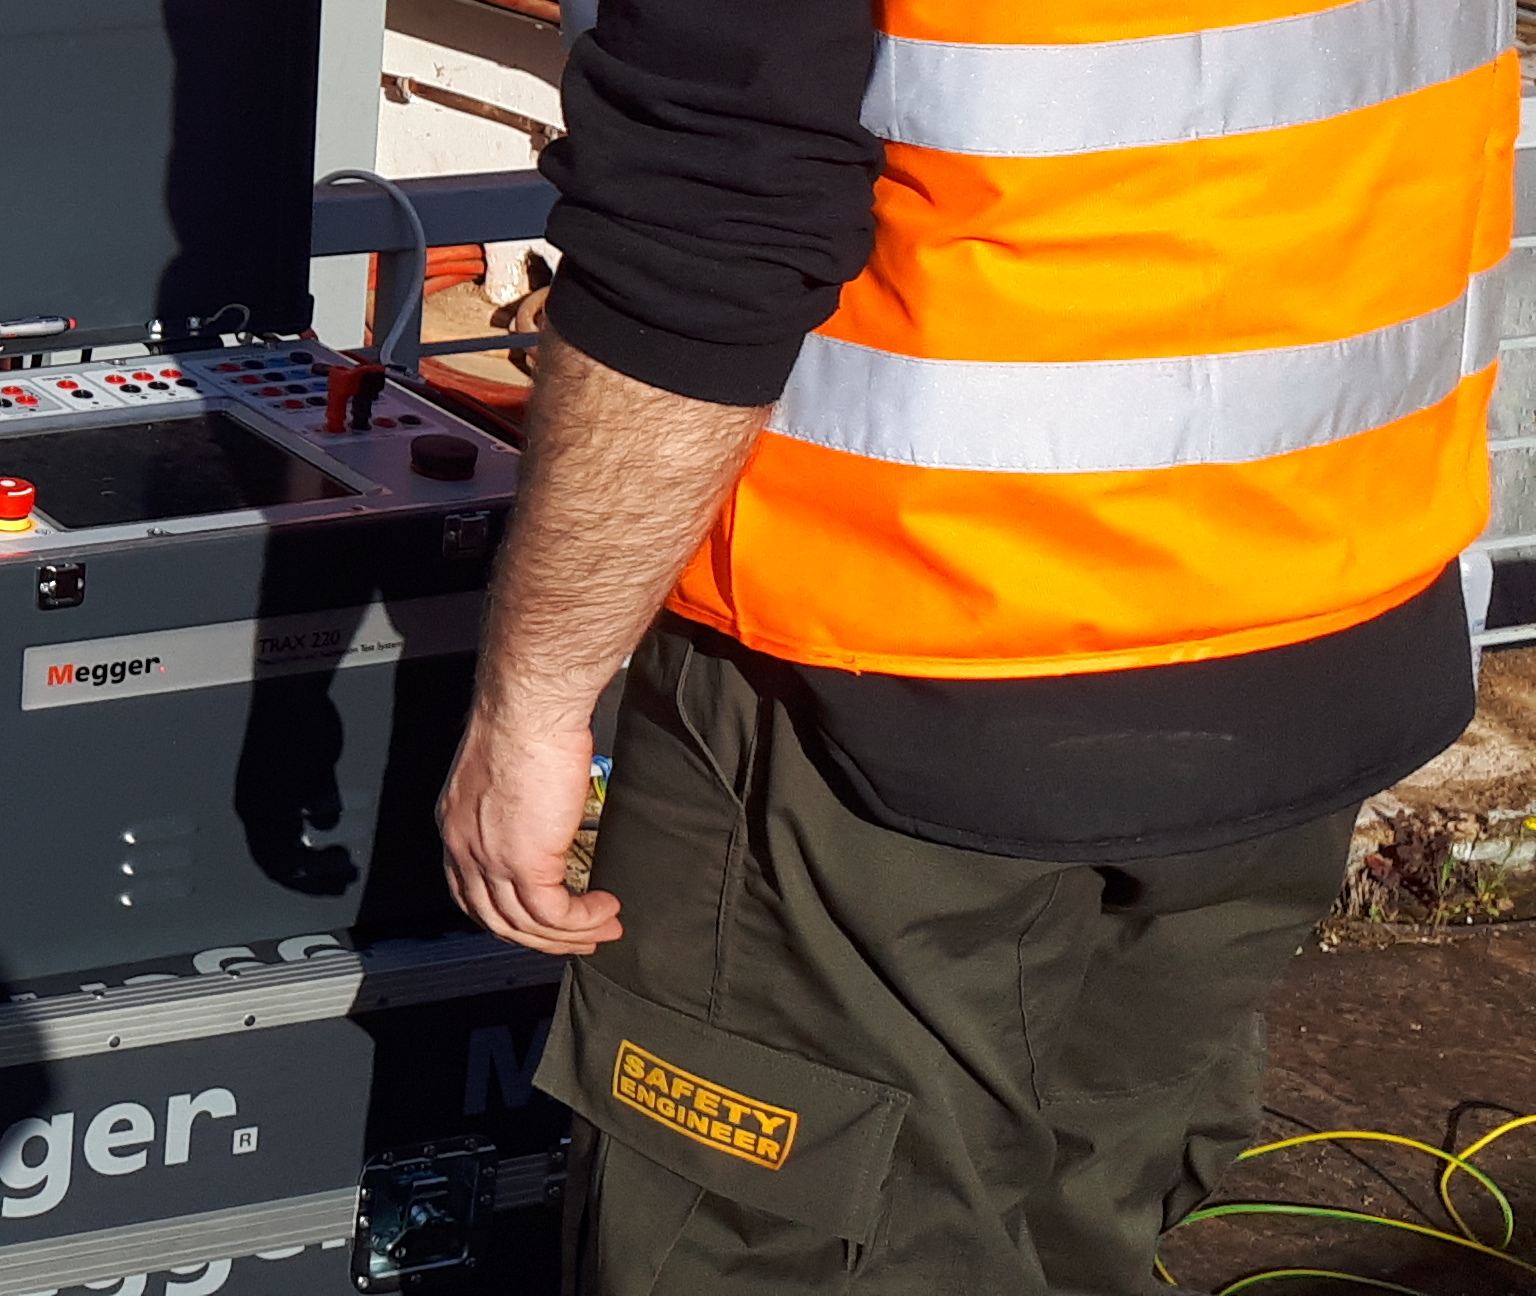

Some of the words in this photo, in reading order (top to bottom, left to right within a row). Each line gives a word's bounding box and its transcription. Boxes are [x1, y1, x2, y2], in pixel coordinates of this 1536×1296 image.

[259, 635, 307, 653] TRAX
[312, 629, 341, 648] 220
[619, 1074, 782, 1161] ENGINEER
[622, 1053, 788, 1136] SAFETY
